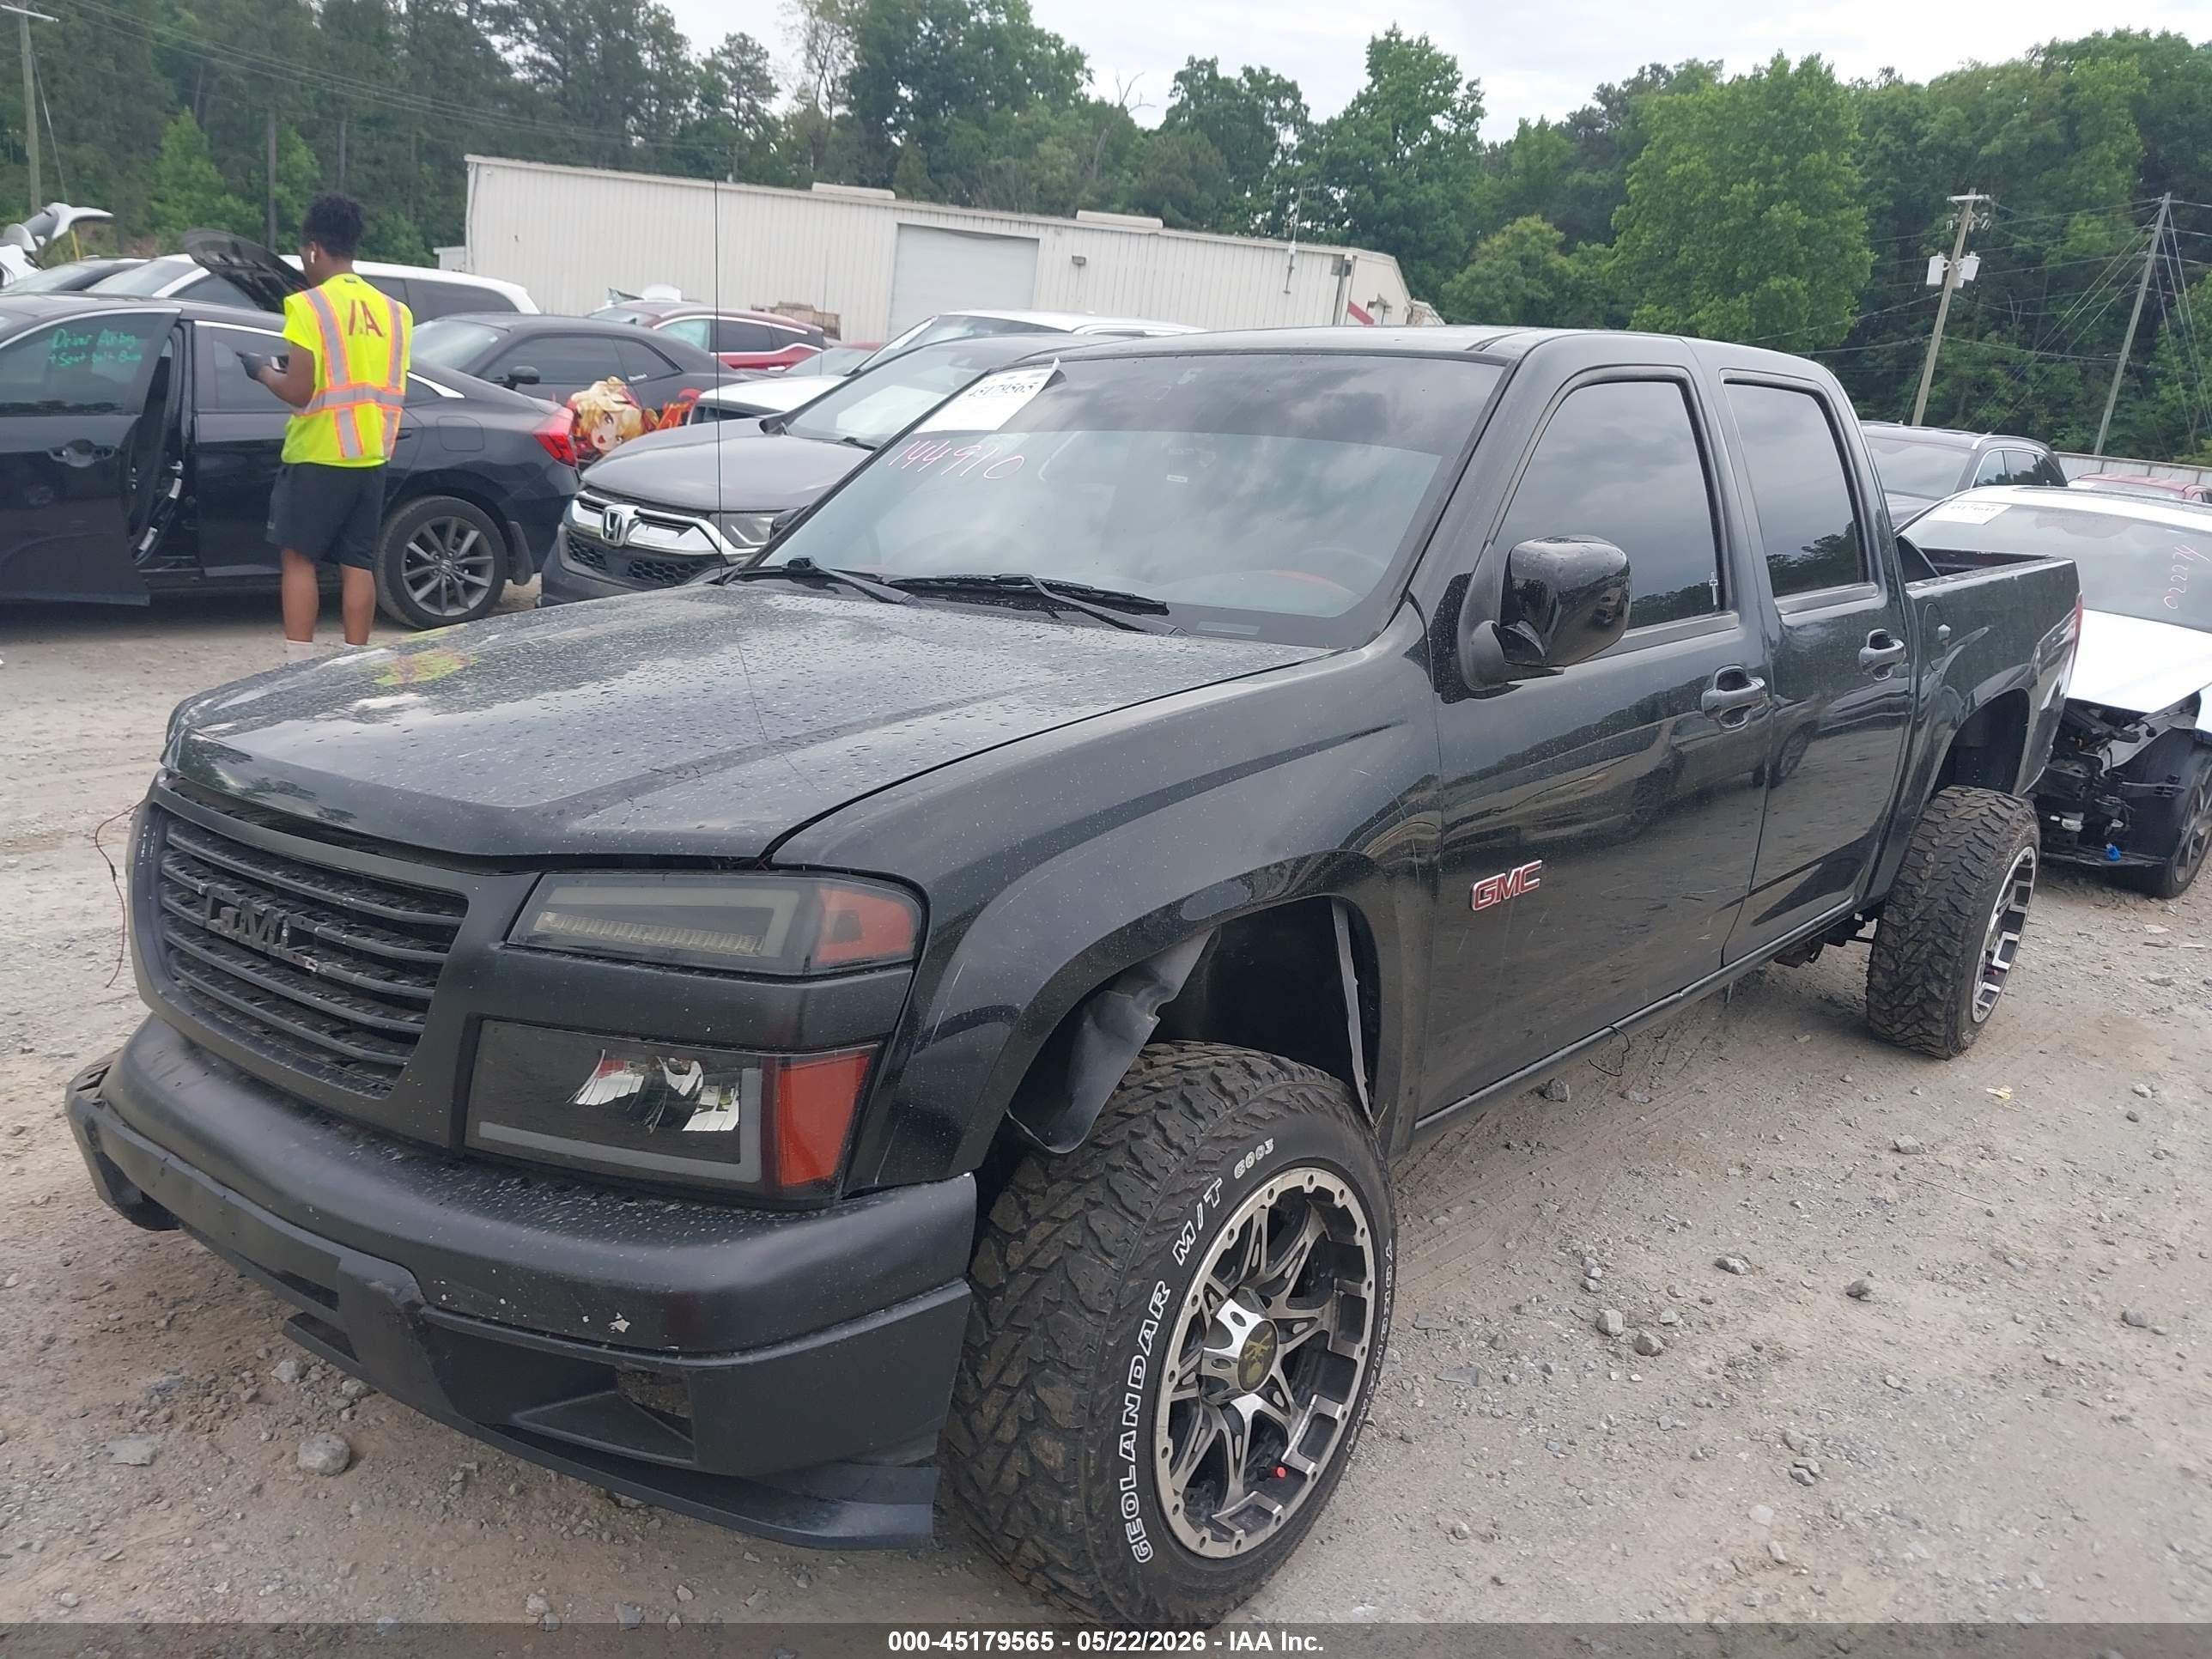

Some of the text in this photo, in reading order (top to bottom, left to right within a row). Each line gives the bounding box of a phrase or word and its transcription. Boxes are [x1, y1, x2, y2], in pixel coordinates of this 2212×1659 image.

[888, 440, 1025, 479] 144910
[1472, 859, 1543, 911] GMC
[198, 882, 319, 974] GMC
[1119, 1137, 1274, 1564] GEOLANDAR M/T G003
